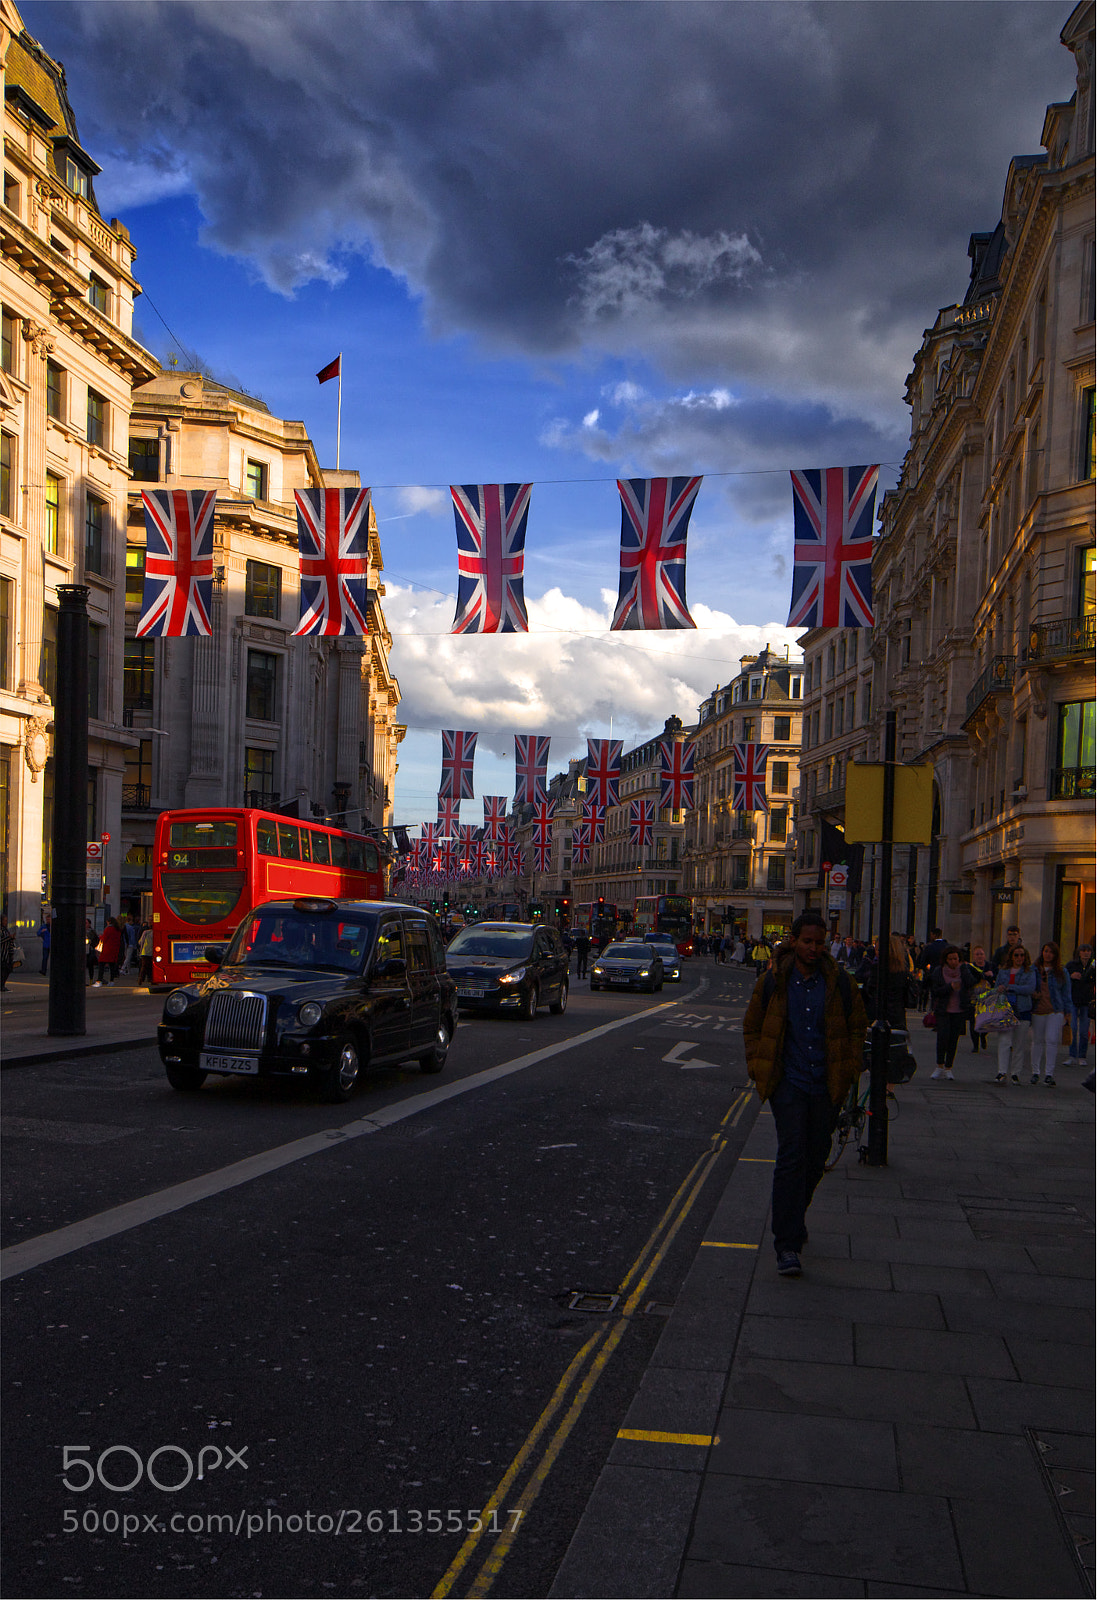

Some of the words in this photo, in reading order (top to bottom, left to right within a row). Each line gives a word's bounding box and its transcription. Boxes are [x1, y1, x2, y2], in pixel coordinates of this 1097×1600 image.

[173, 853, 189, 866] 94
[206, 1056, 228, 1068] KF15
[230, 1059, 252, 1071] ZZS
